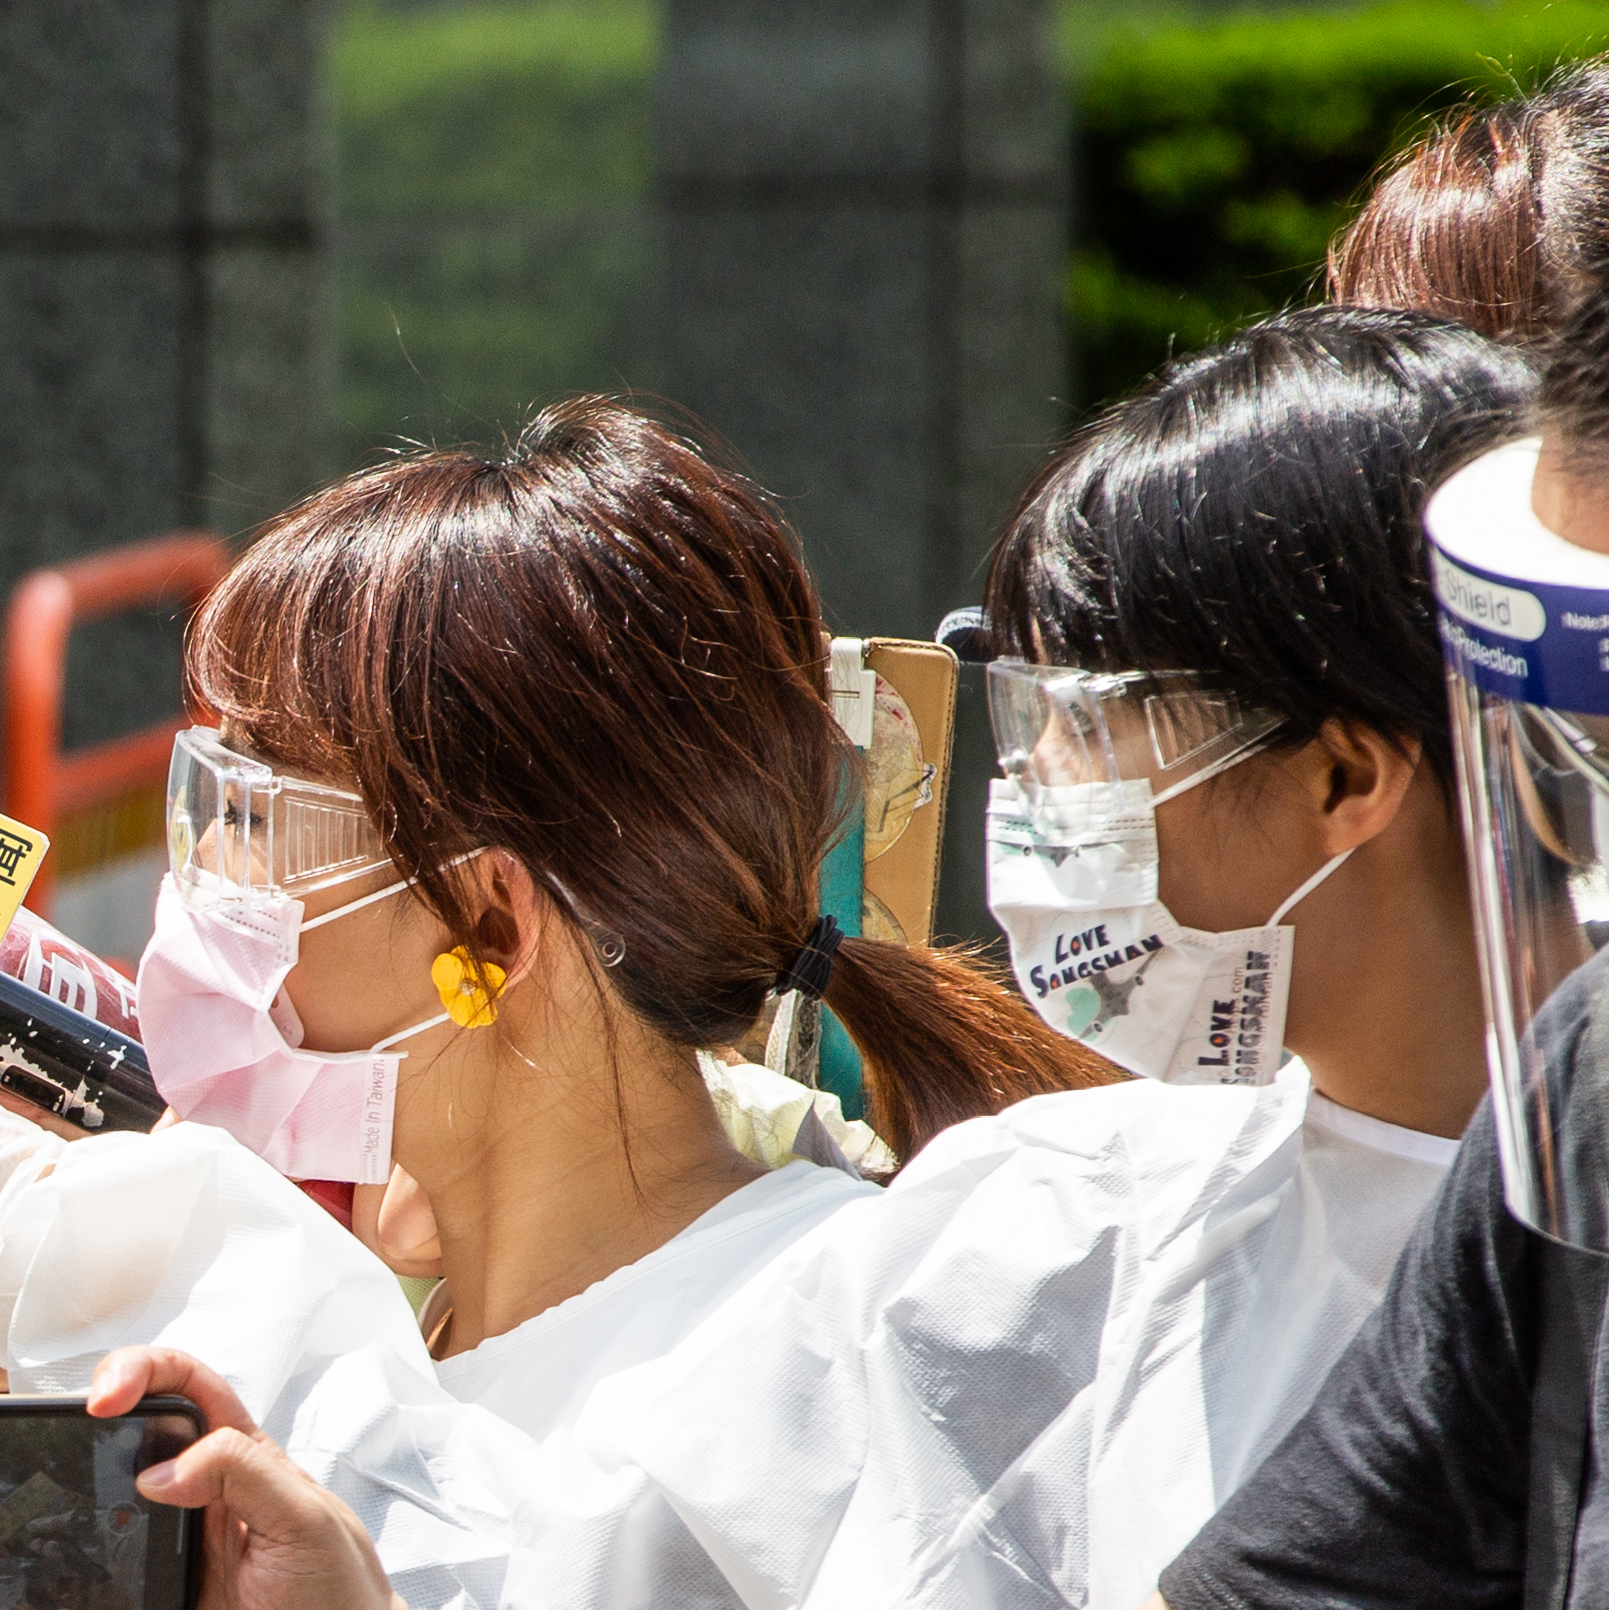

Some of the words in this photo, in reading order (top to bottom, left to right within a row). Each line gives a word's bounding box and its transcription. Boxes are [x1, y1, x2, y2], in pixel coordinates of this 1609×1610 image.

[1445, 568, 1512, 627] Shield
[1030, 934, 1165, 999] SONGSMAN
[1055, 923, 1111, 965] LOVE
[1197, 999, 1236, 1066] LOVE
[363, 1127, 381, 1153] Made
[366, 1111, 381, 1123] In
